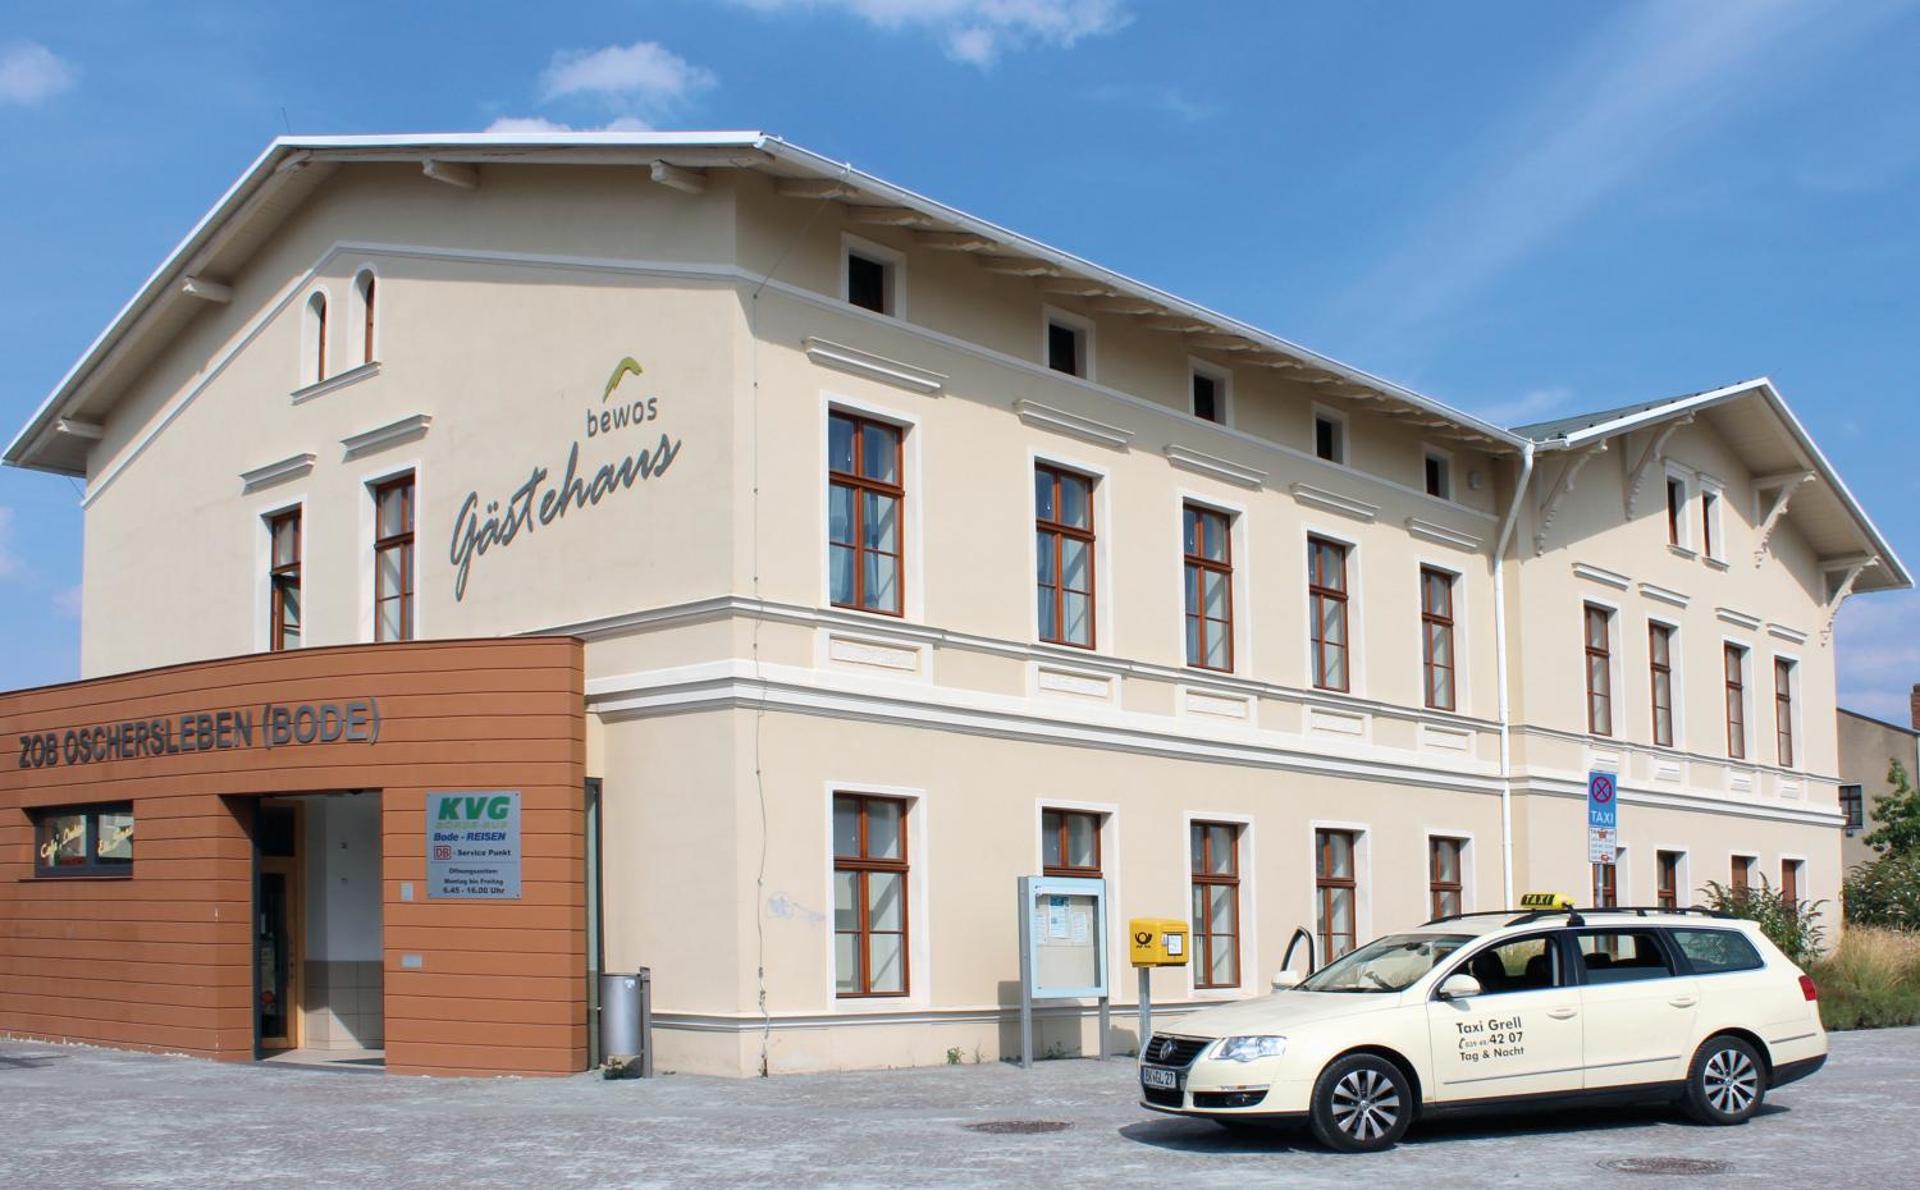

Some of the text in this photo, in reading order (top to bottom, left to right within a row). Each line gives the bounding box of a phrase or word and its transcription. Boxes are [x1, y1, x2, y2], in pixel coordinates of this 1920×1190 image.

[586, 397, 658, 438] bewos
[450, 434, 682, 602] Gästehaus
[19, 696, 381, 768] ZOB OSCHERSLEBEN (BODE)
[438, 795, 511, 820] KVG
[1590, 810, 1614, 826] TAXI
[433, 831, 459, 841] Bode
[466, 831, 507, 841] REISEN
[435, 847, 450, 859] DB
[457, 849, 486, 857] Service
[488, 849, 511, 857] Punkt
[1524, 894, 1552, 905] TAXI
[1456, 1016, 1522, 1034] Taxi Grell
[1489, 1034, 1504, 1045] 42
[1508, 1031, 1523, 1043] 07
[1460, 1046, 1524, 1062] Tag & Nacht
[1165, 1071, 1174, 1086] 27
